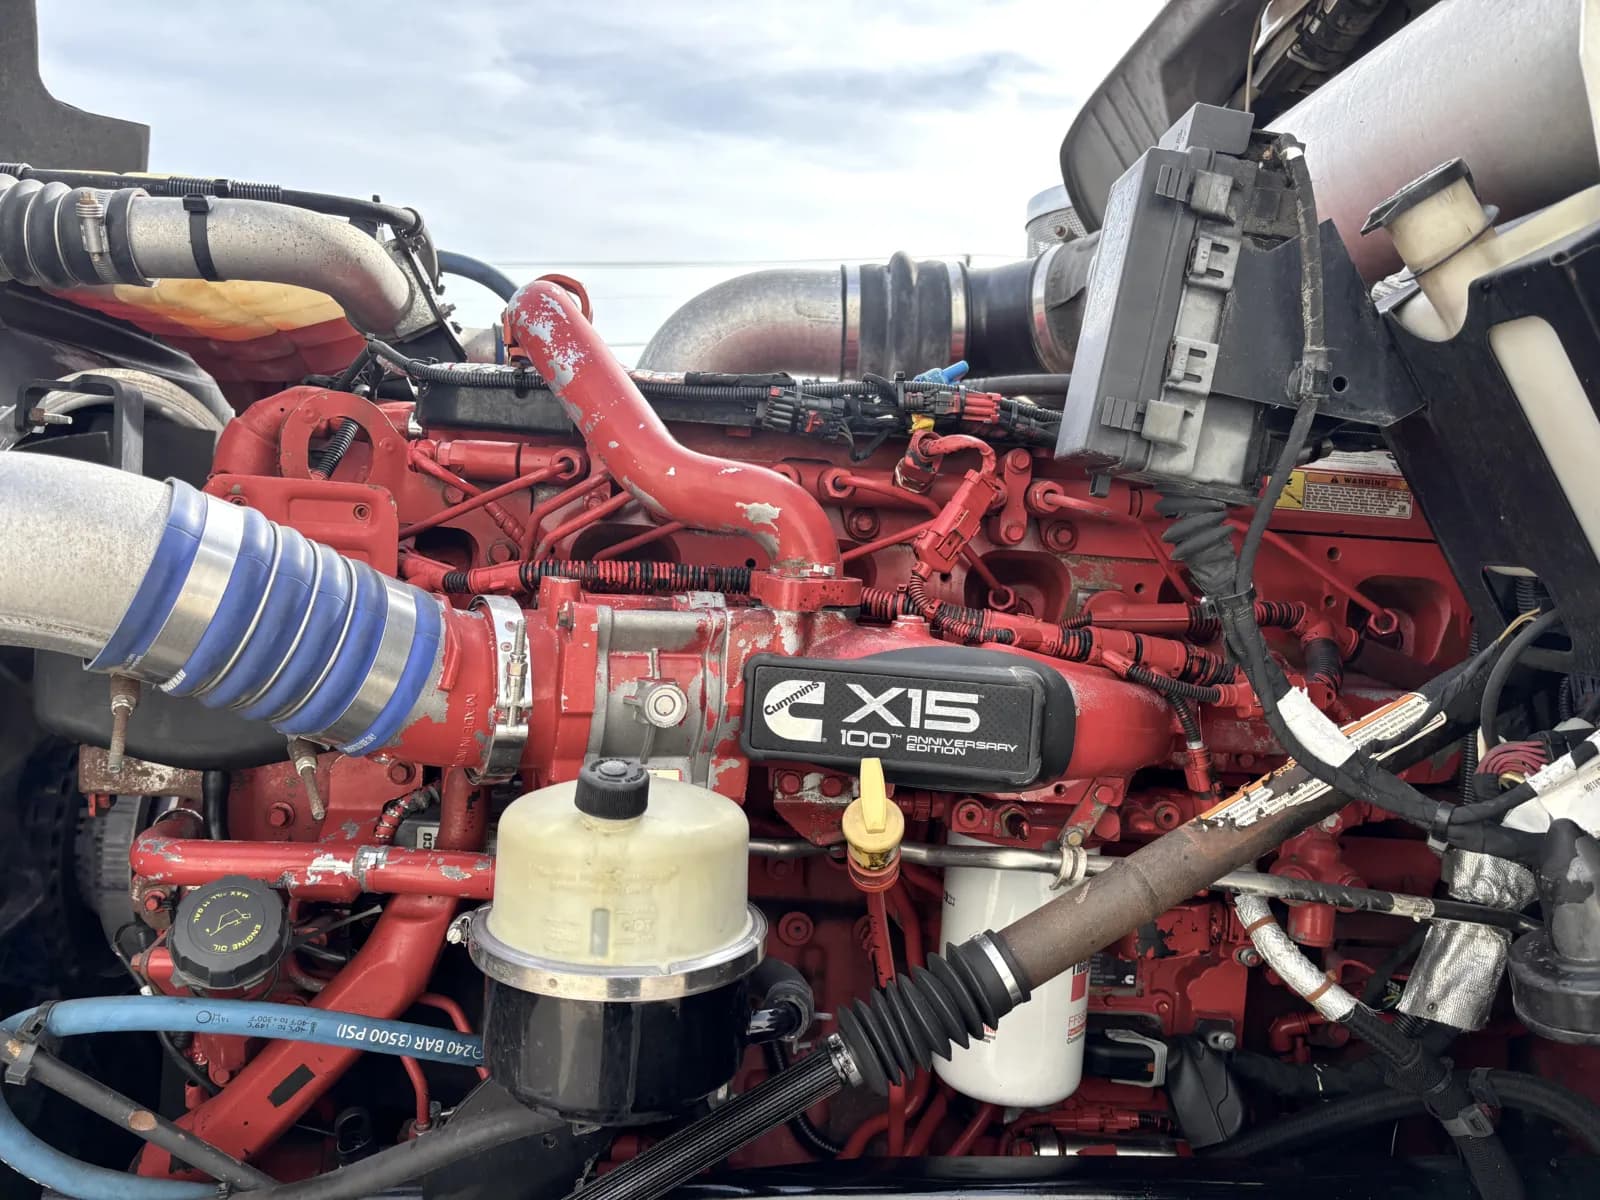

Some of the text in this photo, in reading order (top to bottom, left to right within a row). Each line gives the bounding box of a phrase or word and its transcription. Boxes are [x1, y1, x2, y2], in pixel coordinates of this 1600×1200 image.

[764, 680, 820, 716] Cummins
[842, 683, 980, 733] X15
[906, 735, 1018, 753] ANNIVERSARY
[906, 743, 966, 756] EDITION
[193, 908, 204, 924] GAL
[213, 923, 262, 952] ENGINE OIL
[336, 1023, 366, 1041] PSI)
[369, 1028, 412, 1049] (3500
[413, 1036, 443, 1053] BAR
[446, 1041, 473, 1059] 240
